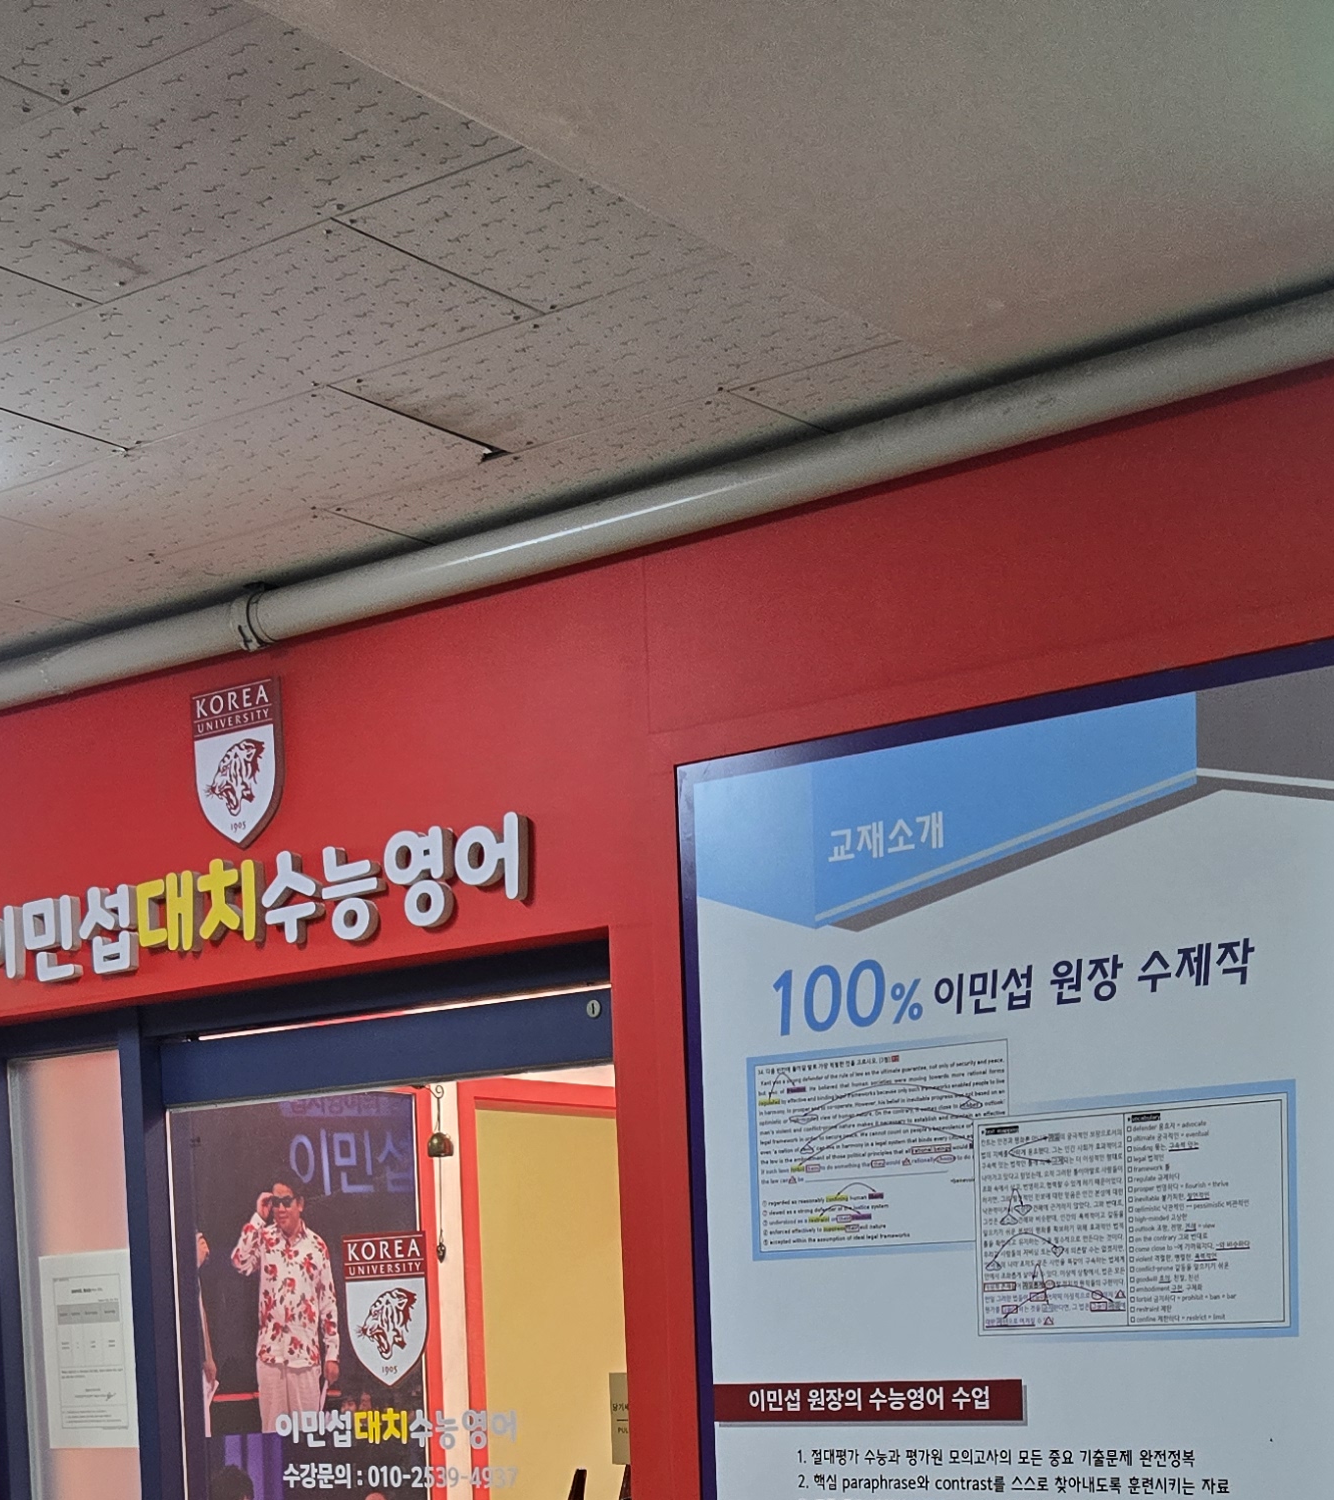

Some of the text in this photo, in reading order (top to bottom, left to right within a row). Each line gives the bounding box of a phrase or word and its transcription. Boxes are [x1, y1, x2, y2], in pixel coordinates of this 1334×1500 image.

[196, 685, 269, 718] KOREA
[198, 709, 269, 733] UNIVERSITY
[231, 821, 246, 832] 1905
[827, 810, 945, 864] 교재소개
[771, 937, 1256, 1038] 100% 이민섭 원장 수제작
[347, 1239, 420, 1261] KOREA
[349, 1262, 421, 1276] UNIVERSITY
[382, 1366, 398, 1374] 1905
[748, 1385, 990, 1412] 이민섭 원장의 수능영어 수업
[276, 1408, 517, 1449] 이민섭대치수능영어
[797, 1449, 1195, 1468] 1. 절대평가 수능과 평가원 모의고사의 모든 중요 기출문제 완전정복
[283, 1463, 352, 1489] 수강문의
[367, 1465, 517, 1488] 010-2539-4937
[798, 1474, 1230, 1495] 2. 핵심 paraphrase와 contrast를 스스로 찾아내도록 훈련시키는 자료
